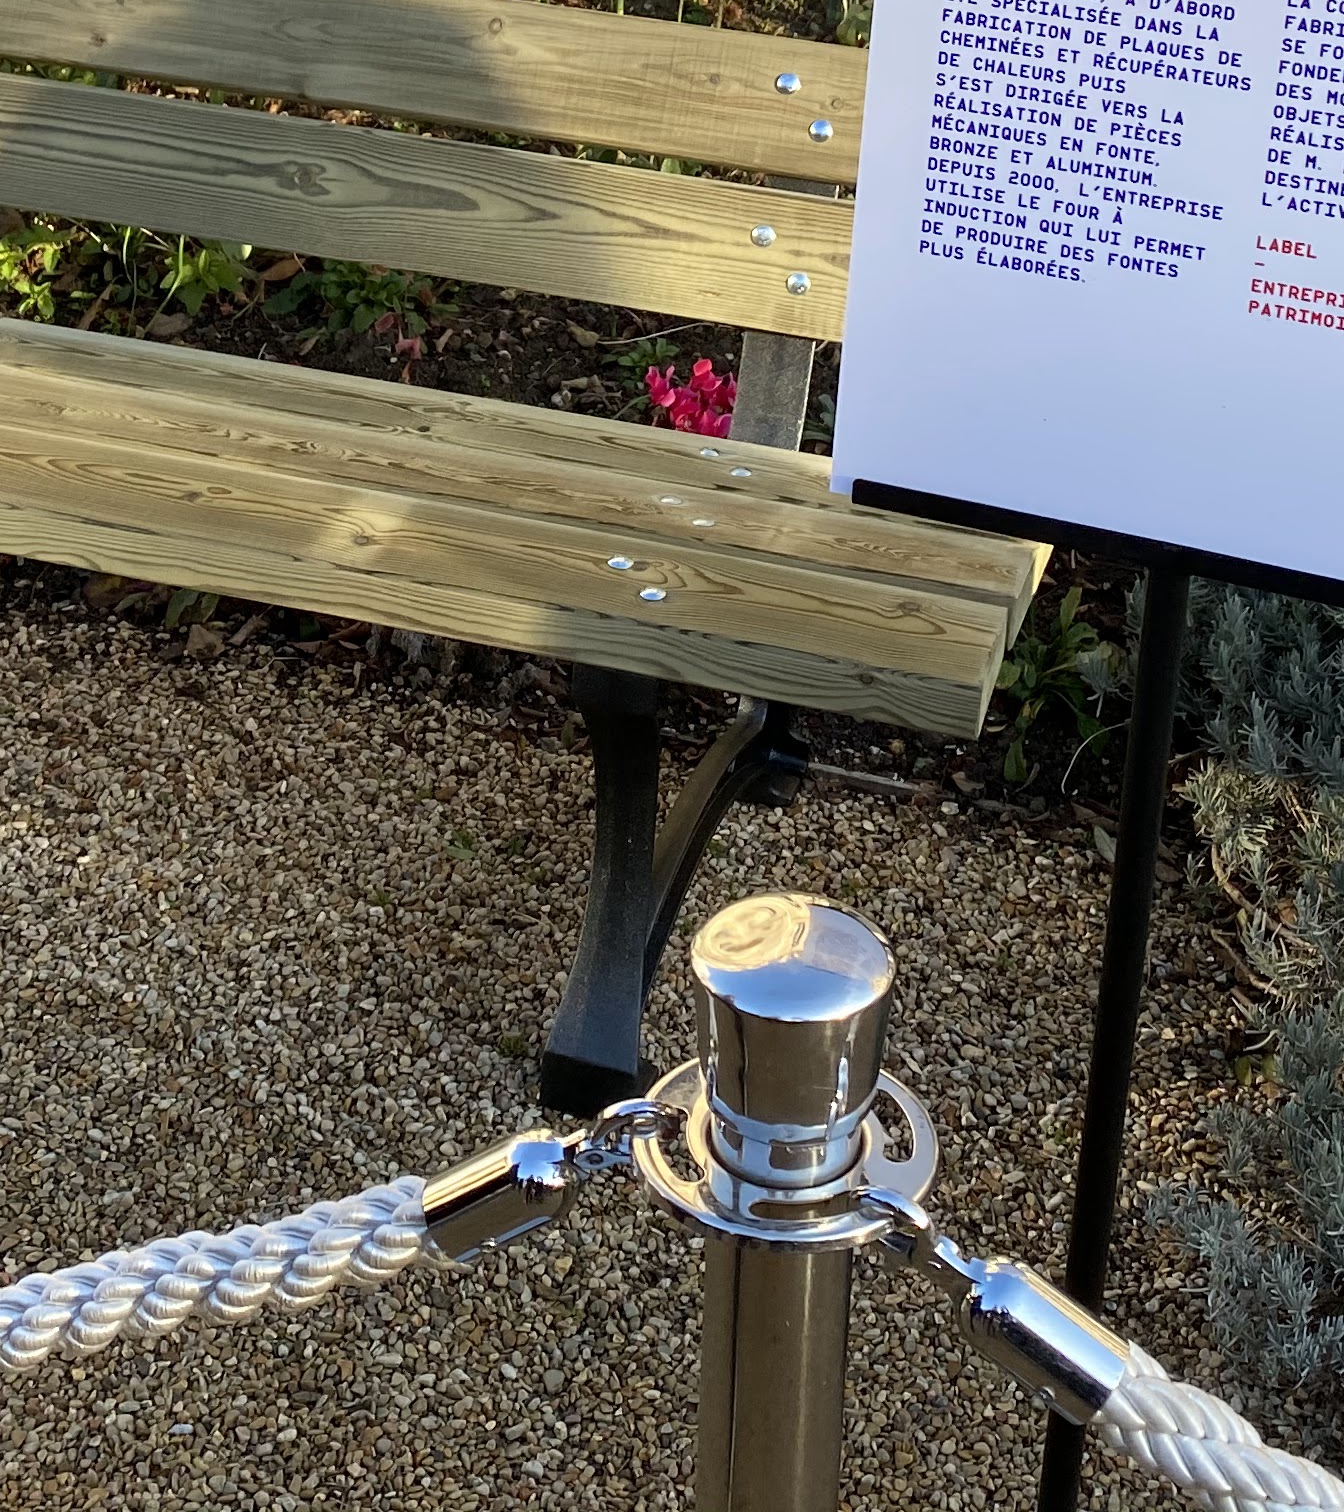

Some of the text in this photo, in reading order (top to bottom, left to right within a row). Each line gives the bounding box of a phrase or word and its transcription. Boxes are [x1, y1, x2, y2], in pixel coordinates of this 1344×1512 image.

[940, 6, 1243, 68] FABRICATION DE PLAQUES DE
[1133, 14, 1184, 36] DANS
[1194, 23, 1220, 42] LA
[1280, 36, 1307, 55] SE
[936, 49, 1127, 94] DE CHALEURS PUIS
[939, 28, 1252, 92] CHEMINÉES ET RÉCUPÉRATEURS
[934, 71, 1184, 126] S'EST DIRIGÉE VERS LA
[1274, 80, 1313, 101] DES
[930, 111, 1160, 167] MÉCANIQUES EN FONTE,
[932, 90, 1182, 147] RÉALISATION DE PIÈCES
[928, 134, 1158, 188] BRONZE ET ALUMINIUM.
[1265, 146, 1292, 166] DE
[1303, 153, 1322, 171] M.
[924, 176, 1123, 225] UTILISE LE FOUR À
[926, 155, 1224, 221] DEPUIS 2000, L'ENTREPRISE
[919, 217, 1179, 278] DE PRODUIRE DES FONTES
[922, 197, 1206, 261] INDUCTION QUI LUI PERMET
[1255, 233, 1318, 260] LABEL
[918, 238, 1086, 284] PLUS ÉLABORÉES.
